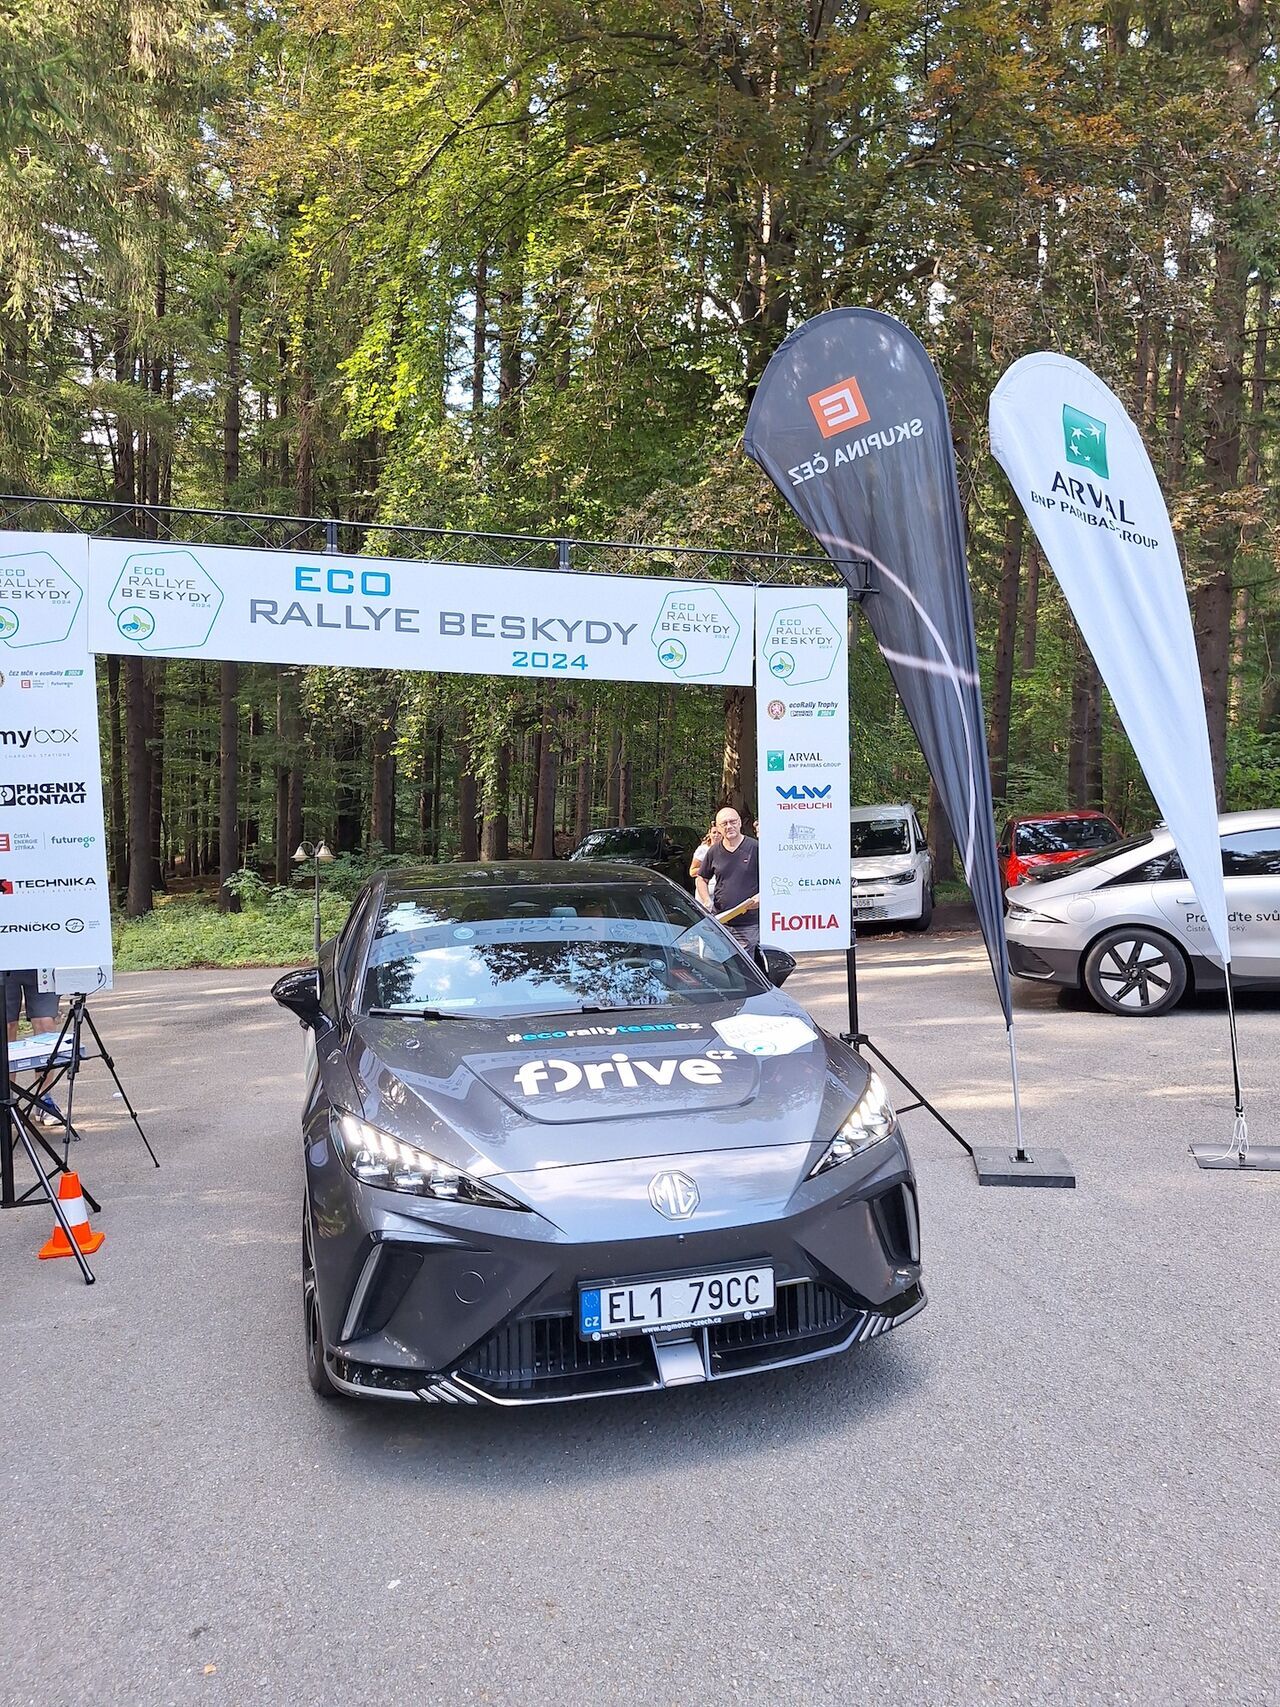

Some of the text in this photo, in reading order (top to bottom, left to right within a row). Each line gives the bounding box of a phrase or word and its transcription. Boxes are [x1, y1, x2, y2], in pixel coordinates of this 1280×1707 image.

[1051, 471, 1135, 525] ARVAL
[1031, 491, 1159, 550] BNP PARIBAS ROUP
[134, 566, 165, 576] ECO
[0, 578, 55, 588] ALLYE
[128, 576, 196, 590] RALLYE
[295, 566, 391, 596] ECO
[0, 590, 71, 600] ESKYDY
[122, 588, 211, 602] BESKYDY
[671, 602, 695, 611] ECO
[250, 599, 638, 645] RALLYE BESKYDY
[667, 612, 719, 623] RALLYE
[661, 622, 730, 634] BESKYDY
[776, 627, 822, 635] RALLYE
[771, 637, 833, 645] BESKYDY
[512, 651, 588, 671] 2024
[818, 701, 838, 709] Trophy
[789, 753, 823, 762] ARVAL
[17, 793, 87, 806] CONTACT
[51, 836, 95, 848] futurego
[15, 877, 96, 889] TECHNIKA
[798, 876, 841, 887] ČELADNÁ
[771, 912, 839, 931] FLOTILA
[506, 1022, 703, 1043] #ecorallyteamcz
[652, 1173, 697, 1216] MG
[608, 1274, 760, 1324] EL1 79CC
[584, 1315, 600, 1328] CZ
[641, 1317, 722, 1334] www.mgmotor-czech.cz
